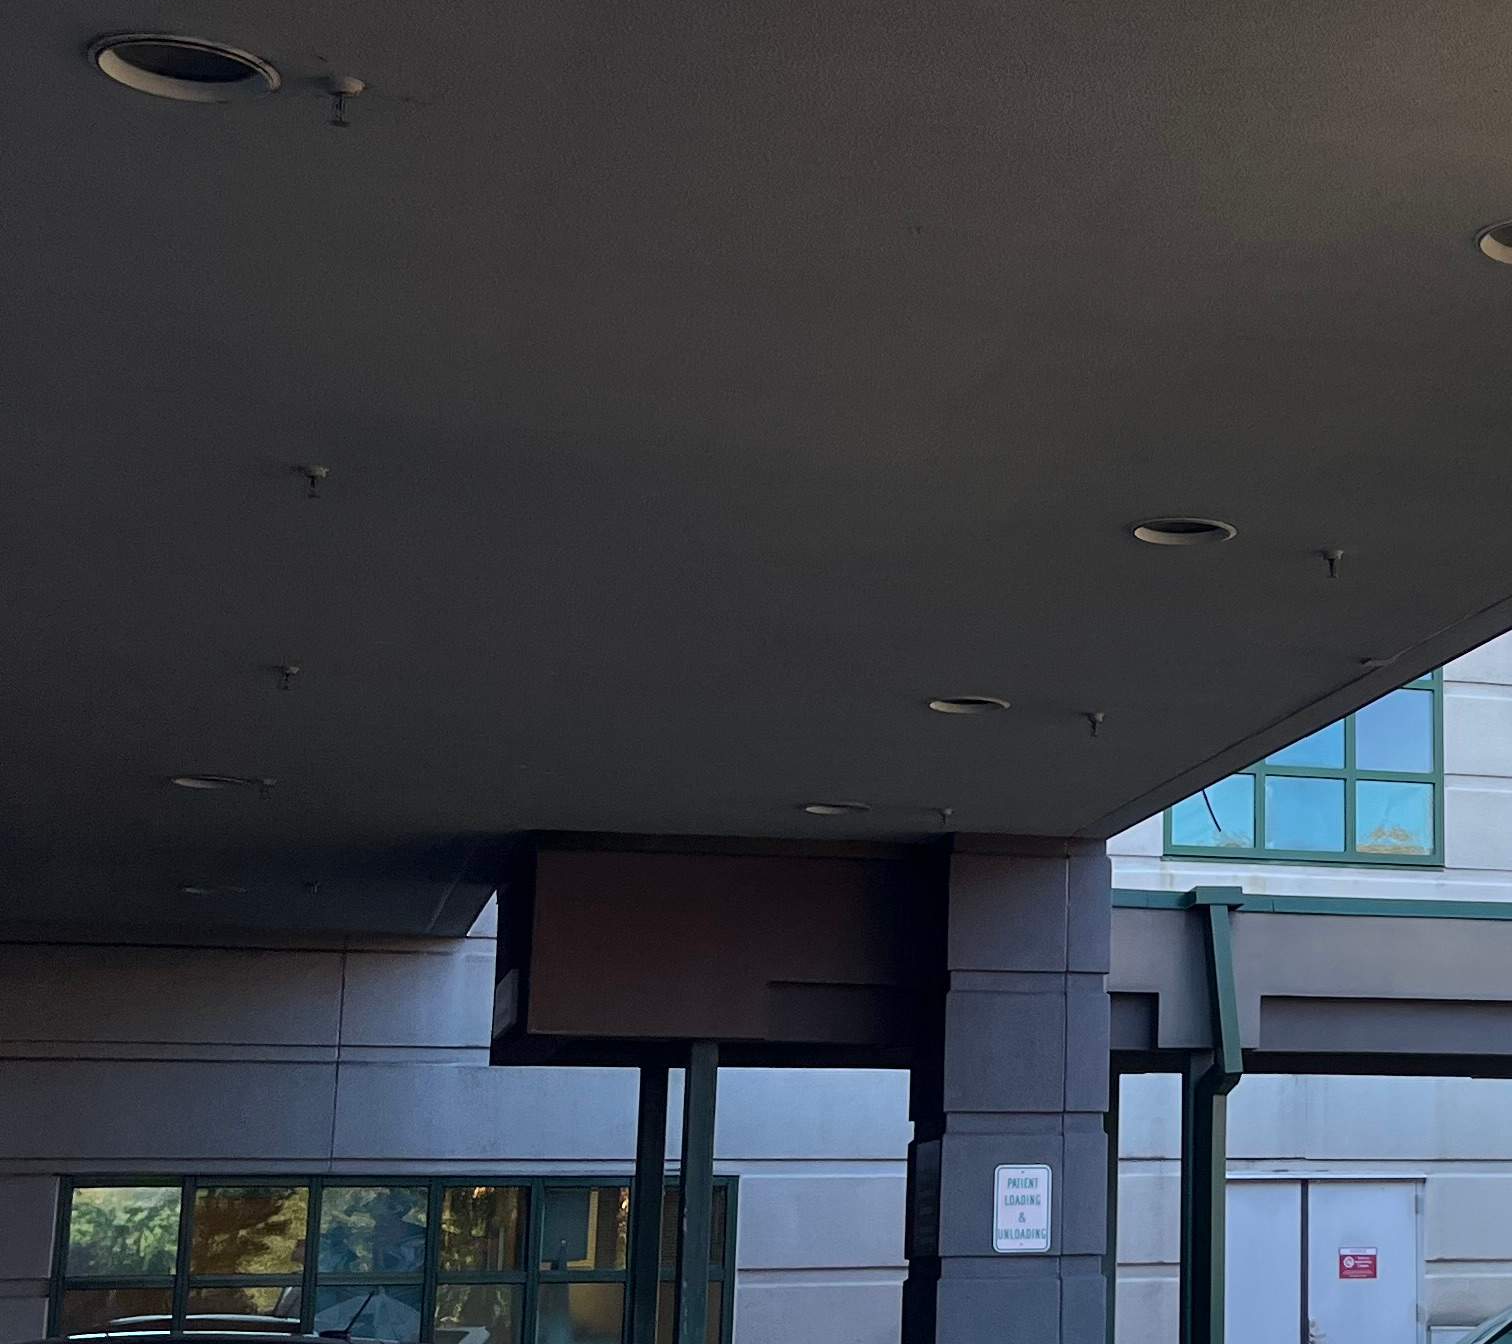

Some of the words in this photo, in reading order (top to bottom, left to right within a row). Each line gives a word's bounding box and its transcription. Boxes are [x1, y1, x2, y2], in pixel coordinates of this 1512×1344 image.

[1007, 1178, 1039, 1189] PATIENT
[1004, 1195, 1041, 1206] LOADING
[1018, 1212, 1026, 1223] &
[998, 1228, 1048, 1240] UNLOADING
